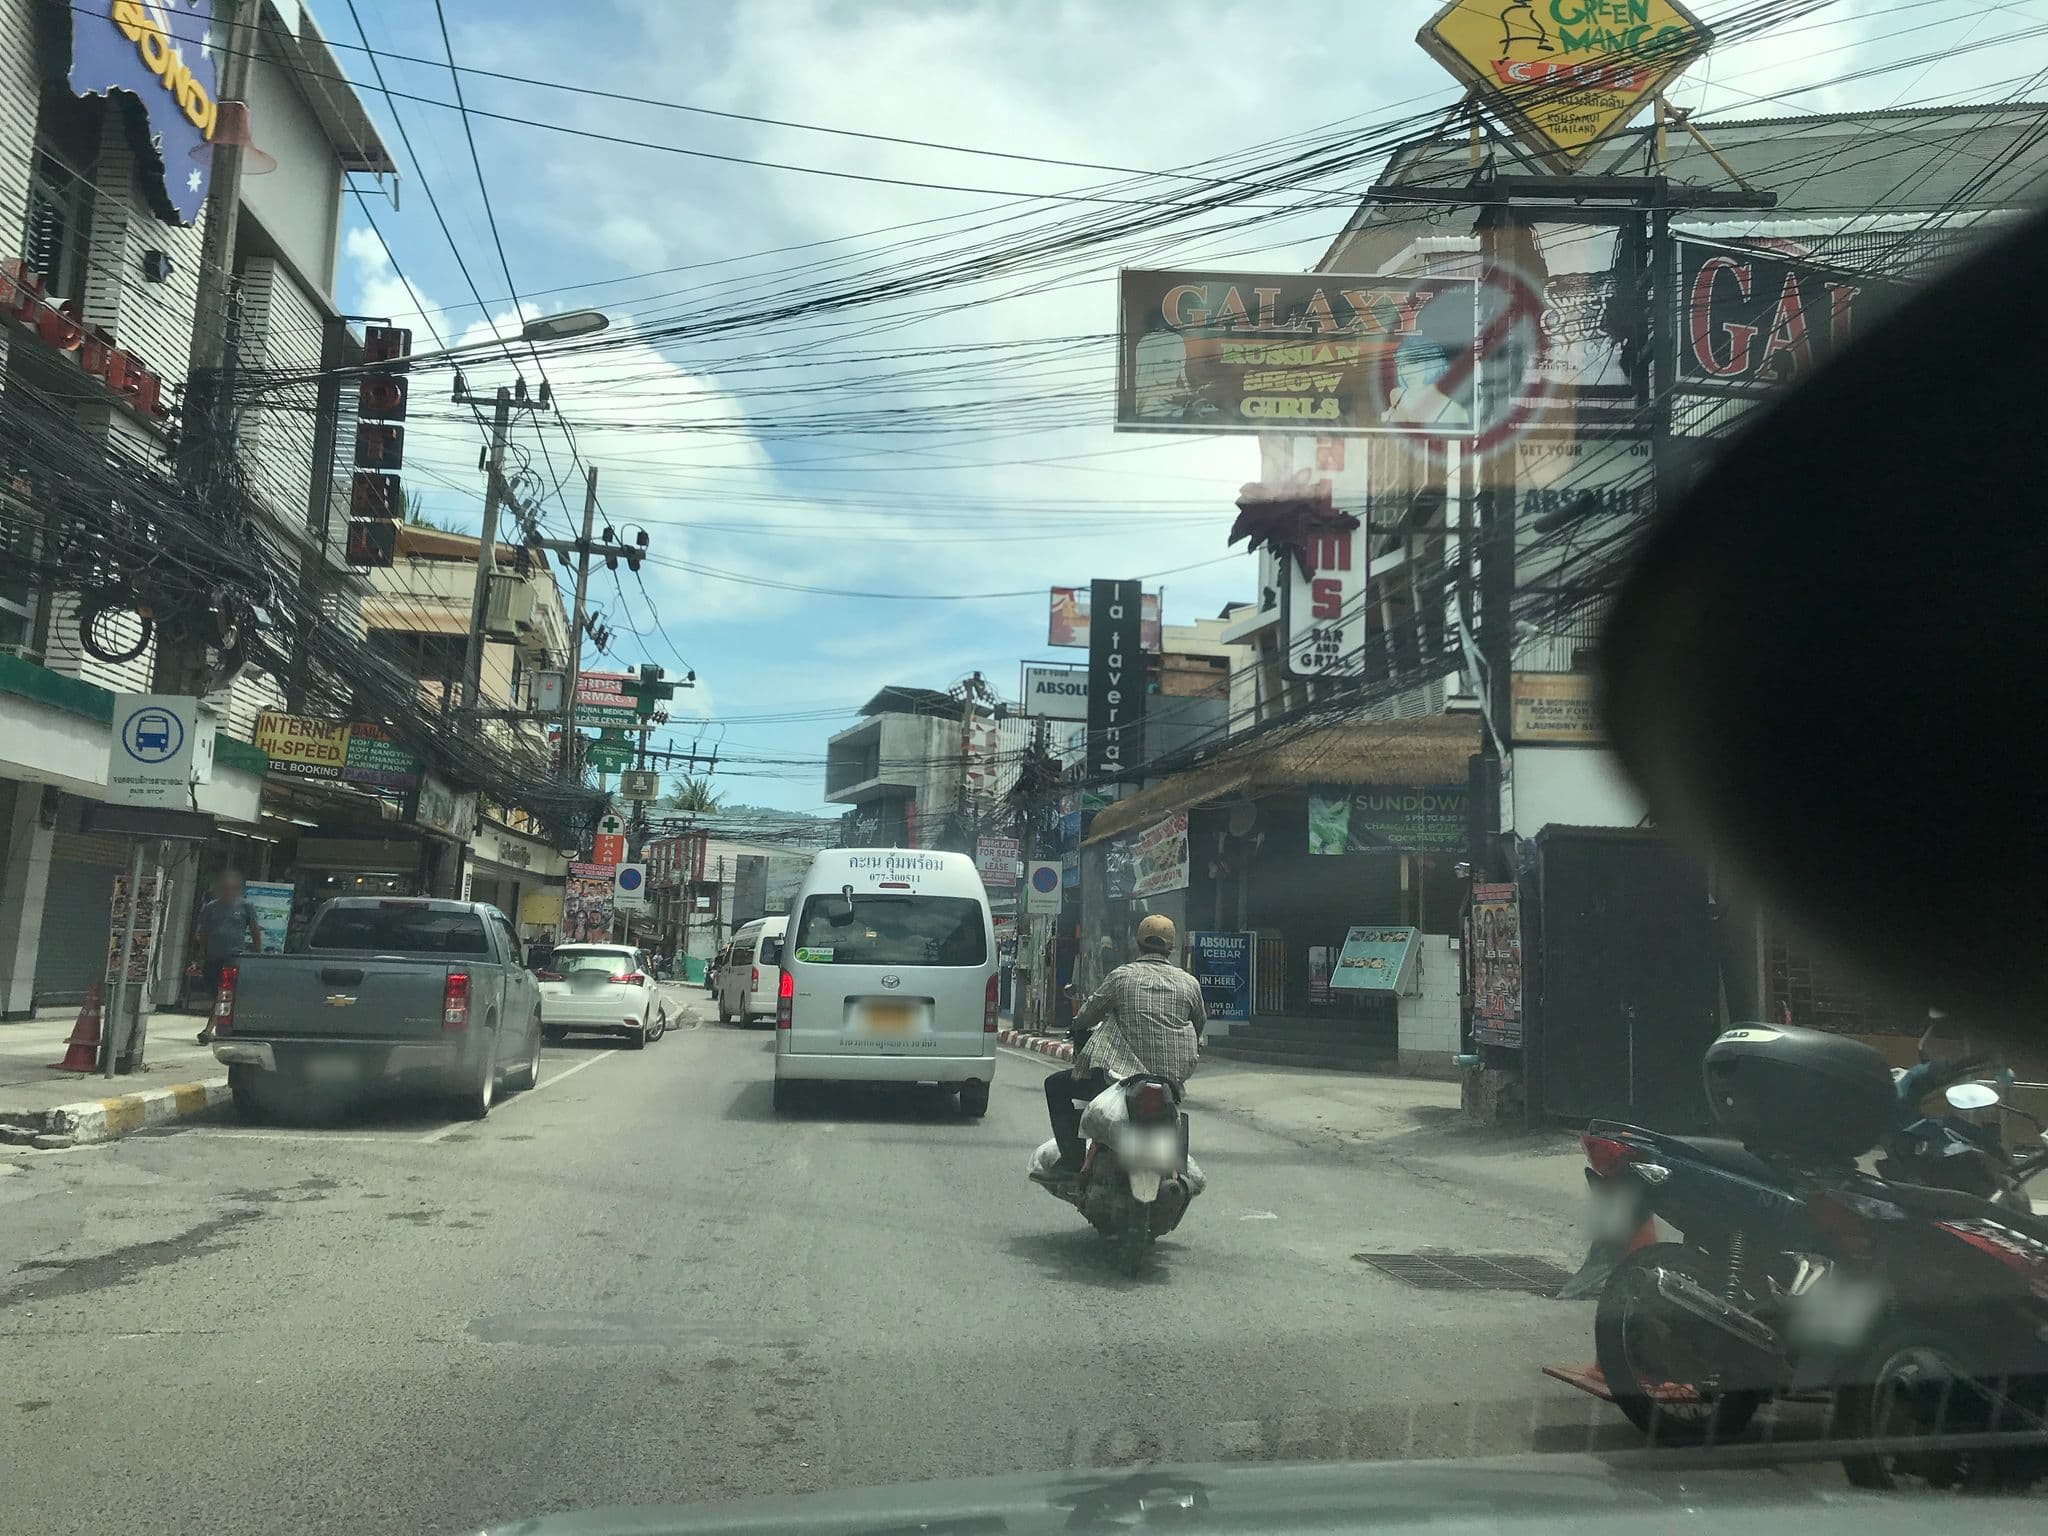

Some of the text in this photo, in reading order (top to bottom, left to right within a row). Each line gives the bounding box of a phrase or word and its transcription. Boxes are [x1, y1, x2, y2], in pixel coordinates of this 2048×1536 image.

[1550, 0, 1649, 25] GREEN
[1559, 25, 1687, 59] MANGO
[112, 0, 217, 140] BONDI
[1549, 124, 1597, 136] THAILAND
[1161, 284, 1434, 337] GALAXY
[1220, 343, 1360, 367] RUSSIAN
[1243, 369, 1345, 393] SHOW
[1239, 397, 1341, 420] GIRLS
[1520, 444, 1543, 456] GET
[1548, 444, 1582, 456] YOUR
[1313, 628, 1343, 643] BAR
[1317, 644, 1339, 653] AND
[1105, 631, 1122, 759] taverna
[602, 708, 636, 717] MEDICINE
[259, 715, 346, 741] INTERNET
[260, 738, 340, 761] HI-SPEED
[290, 763, 338, 777] BOOKING
[980, 848, 1016, 858] FOR SALE
[985, 862, 1009, 871] LEASE
[1203, 948, 1241, 958] ICEBAR
[1201, 976, 1236, 986] IN HERE
[1222, 1009, 1244, 1017] NIGHT
